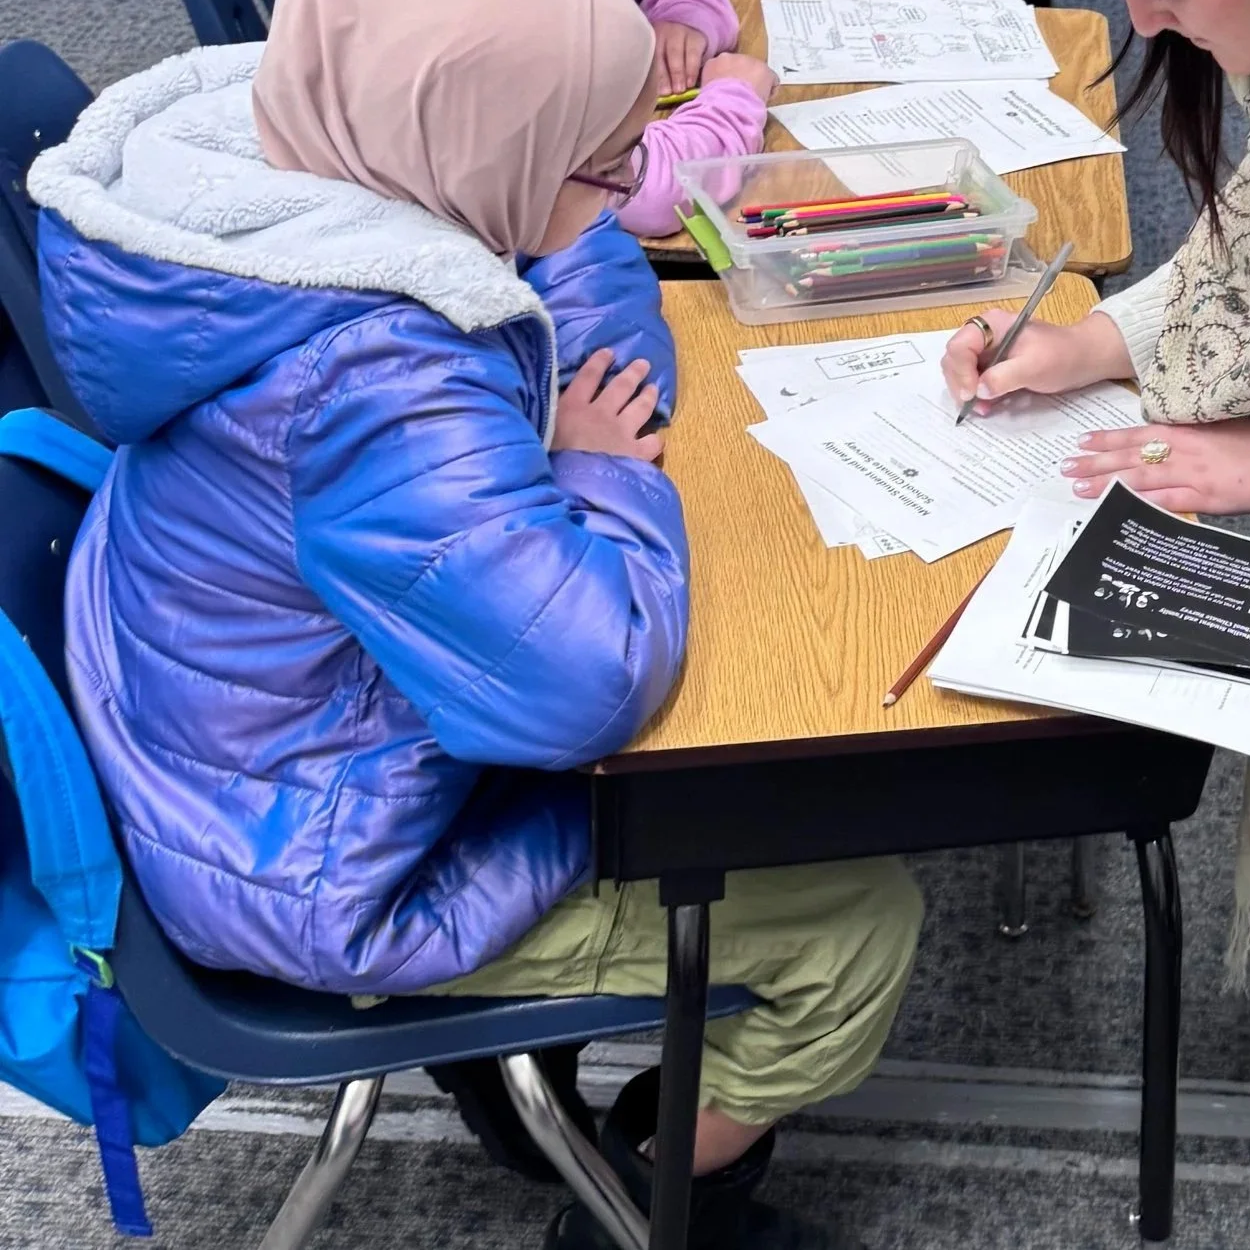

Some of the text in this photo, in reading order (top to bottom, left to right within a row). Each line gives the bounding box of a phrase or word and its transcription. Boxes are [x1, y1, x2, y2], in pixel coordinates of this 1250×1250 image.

[845, 442, 933, 504] School Climate Survey
[823, 442, 929, 516] Muslim Student and Family
[1159, 608, 1183, 618] Family
[1180, 607, 1204, 618] Survey
[1199, 620, 1226, 631] Student
[1205, 615, 1232, 627] Climate
